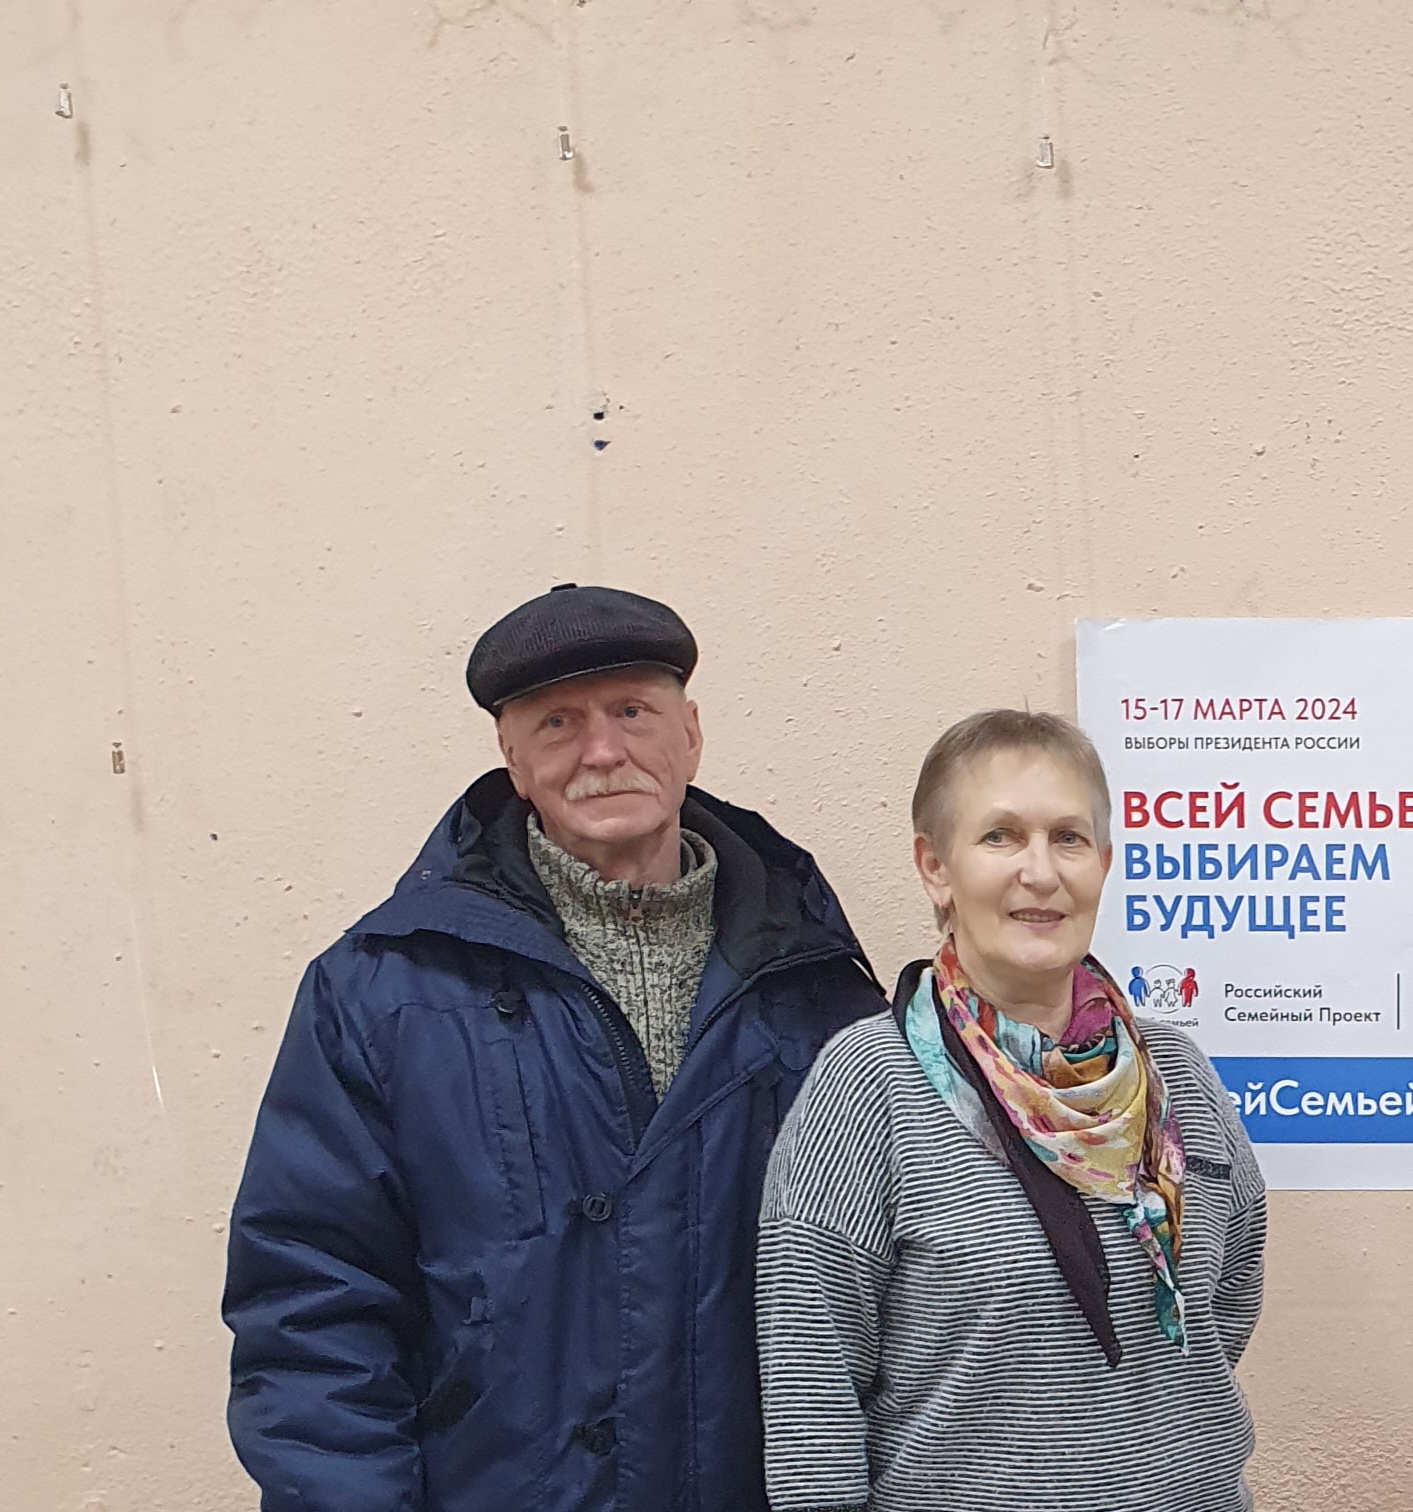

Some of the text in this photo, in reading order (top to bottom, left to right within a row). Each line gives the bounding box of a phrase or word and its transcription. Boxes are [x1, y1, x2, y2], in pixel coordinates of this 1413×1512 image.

[1121, 697, 1358, 721] 15-17 МАРТА 2024
[1124, 736, 1360, 752] ВЫБОРЫ ПРЕЗИДЕНТА РОССИИ
[1123, 781, 1246, 829] ВСЕЙ
[1124, 843, 1391, 881] ВЫБИРАЕМ
[1125, 894, 1347, 940] БУДУЩЕЕ
[1224, 983, 1323, 999] Российский
[1224, 1006, 1382, 1027] Семейный Проект
